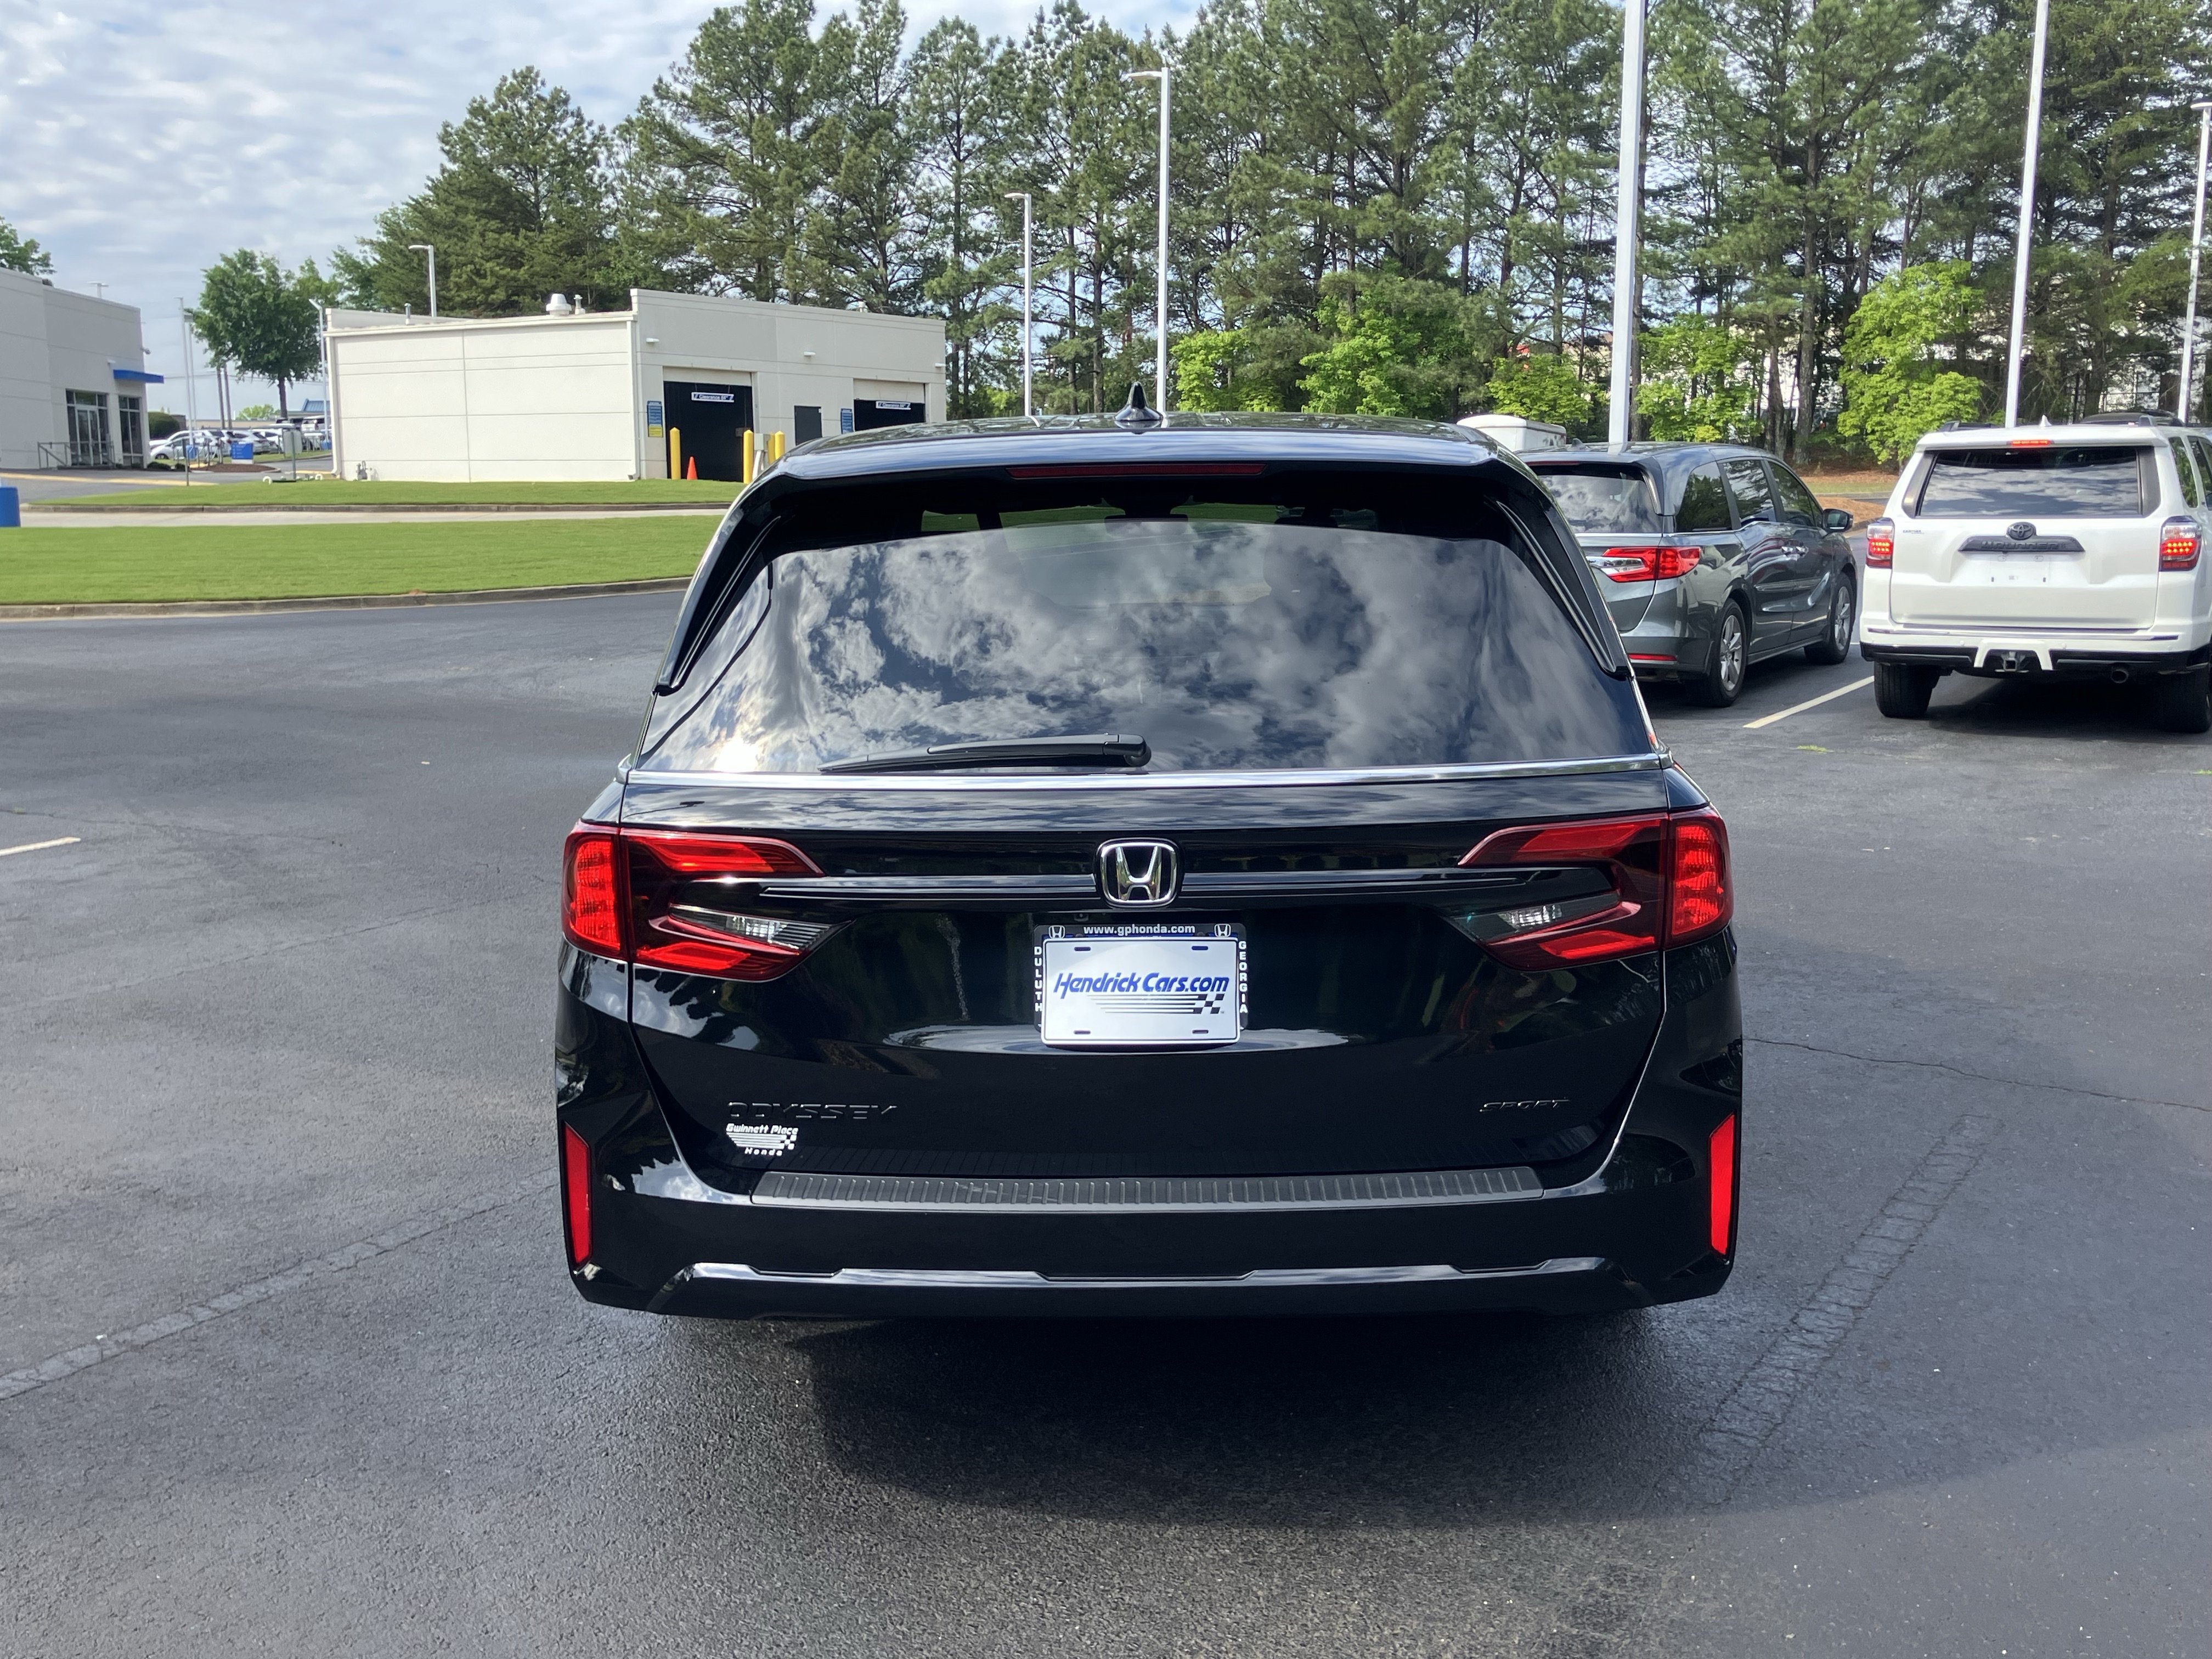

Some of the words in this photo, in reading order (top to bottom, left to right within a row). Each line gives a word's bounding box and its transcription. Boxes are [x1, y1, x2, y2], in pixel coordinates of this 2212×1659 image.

[1083, 923, 1196, 936] www.gphonda.com
[1034, 946, 1042, 1012] DULUTH
[1238, 940, 1248, 1013] GEORGIA
[727, 1102, 898, 1120] ODYSSEY
[726, 1123, 769, 1134] Gwinnett
[770, 1125, 799, 1136] Place
[744, 1147, 783, 1156] Honda
